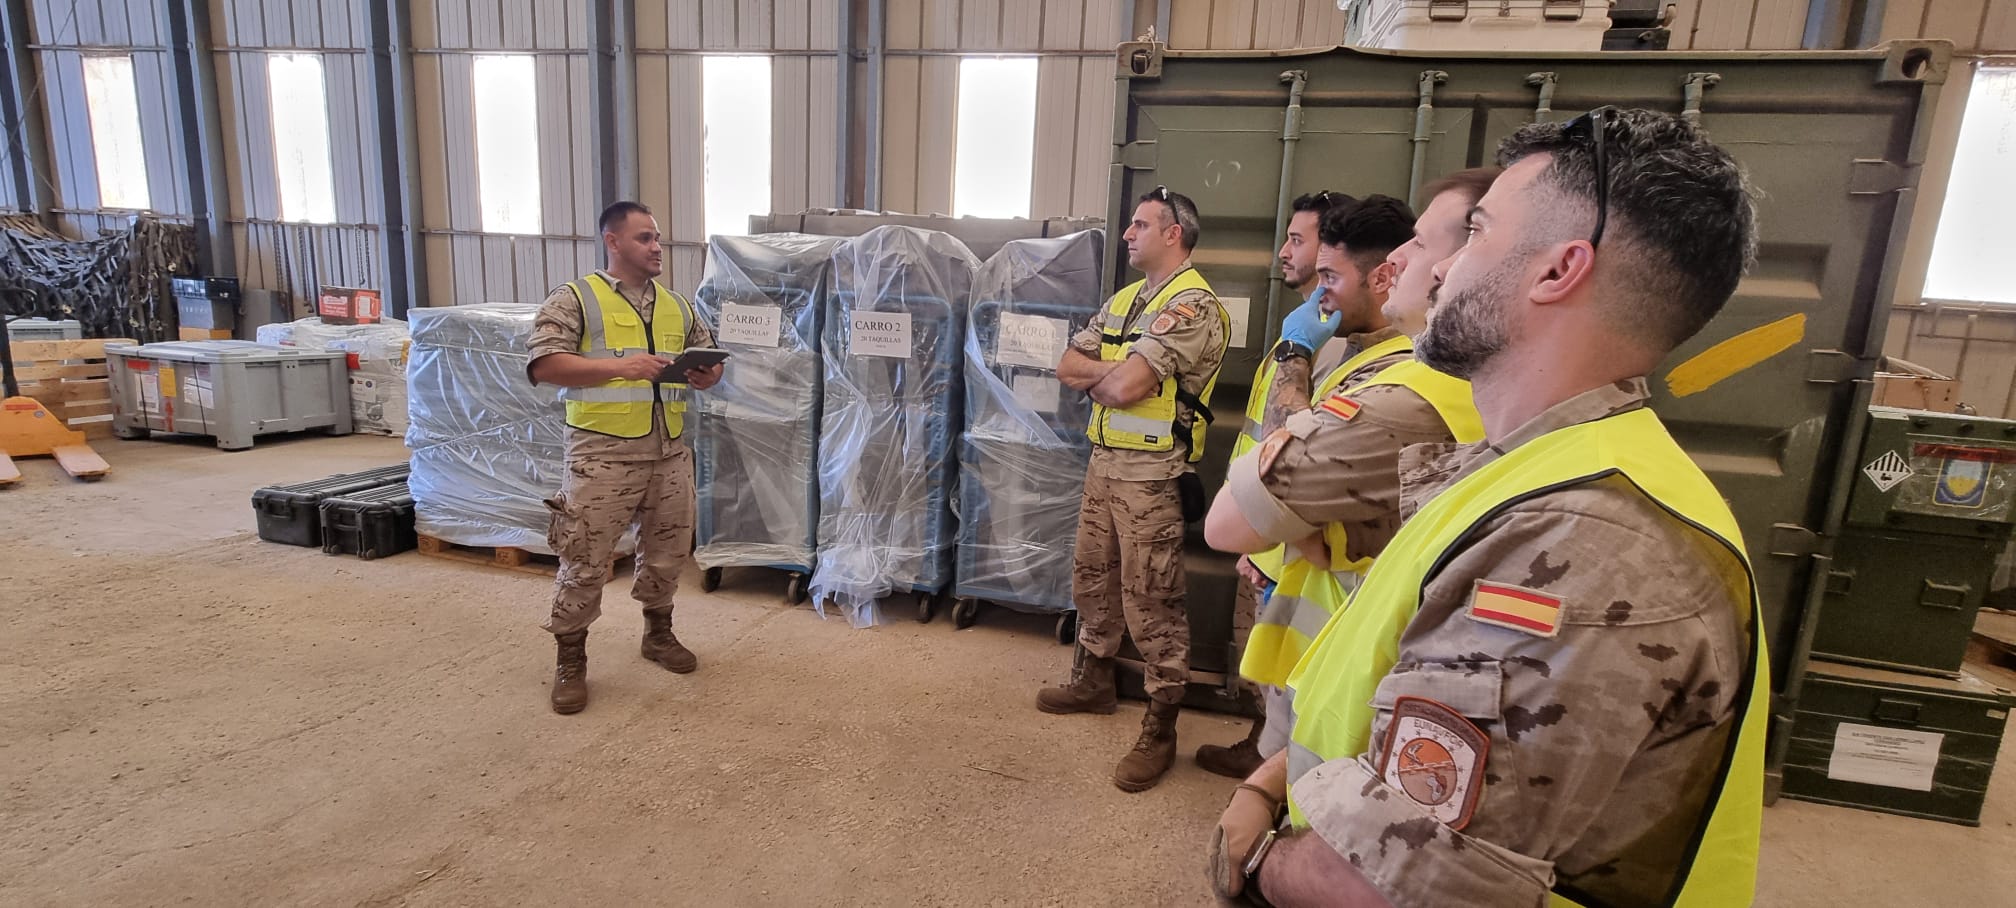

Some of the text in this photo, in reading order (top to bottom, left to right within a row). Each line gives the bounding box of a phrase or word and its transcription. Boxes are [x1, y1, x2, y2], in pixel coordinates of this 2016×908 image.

[726, 313, 771, 327] CARRO 3
[855, 320, 902, 332] CARRO 2
